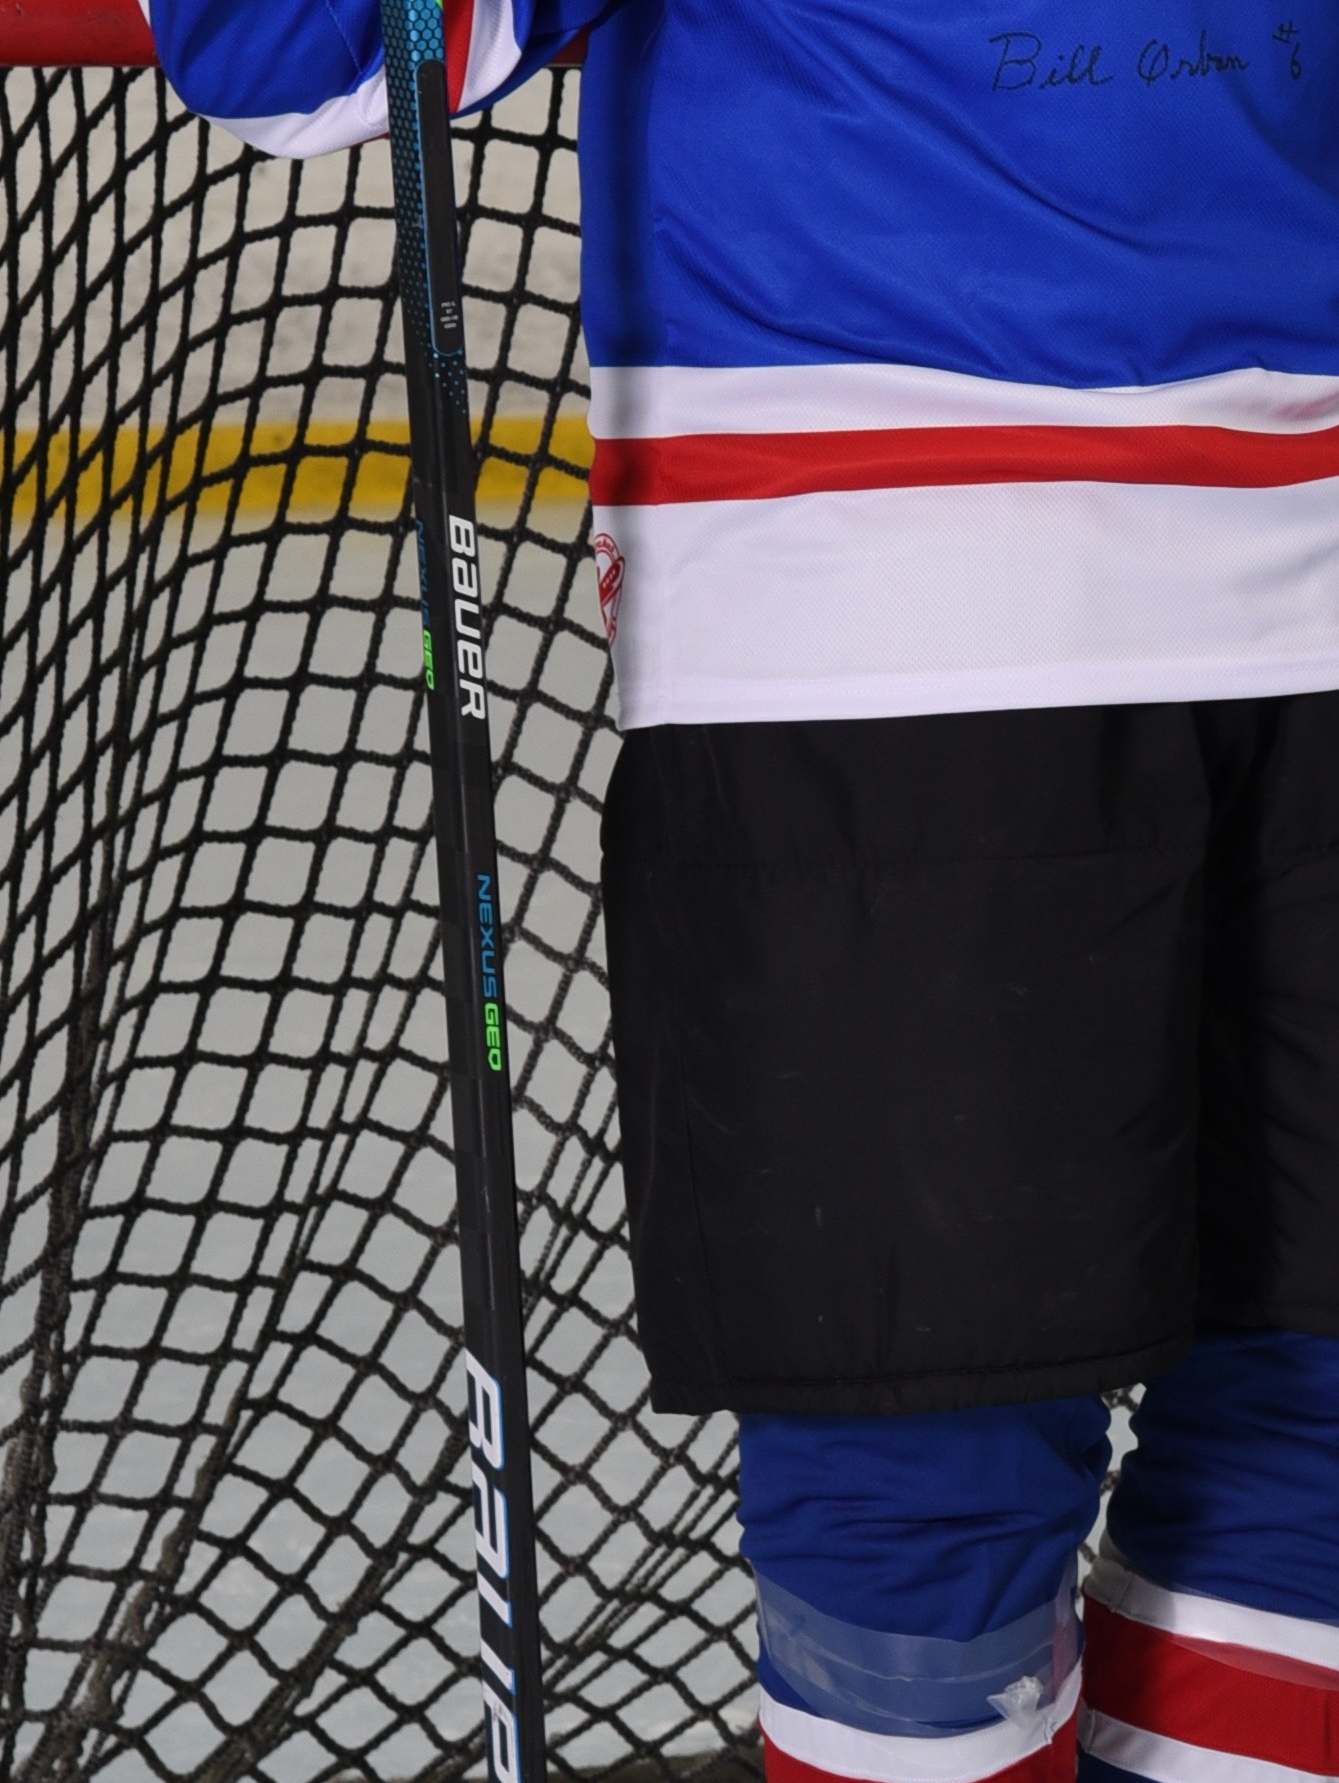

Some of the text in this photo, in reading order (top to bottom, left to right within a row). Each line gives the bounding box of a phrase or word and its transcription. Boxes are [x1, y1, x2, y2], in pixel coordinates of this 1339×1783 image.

[988, 32, 1116, 93] Bill
[477, 873, 502, 1072] NEXUS GEO
